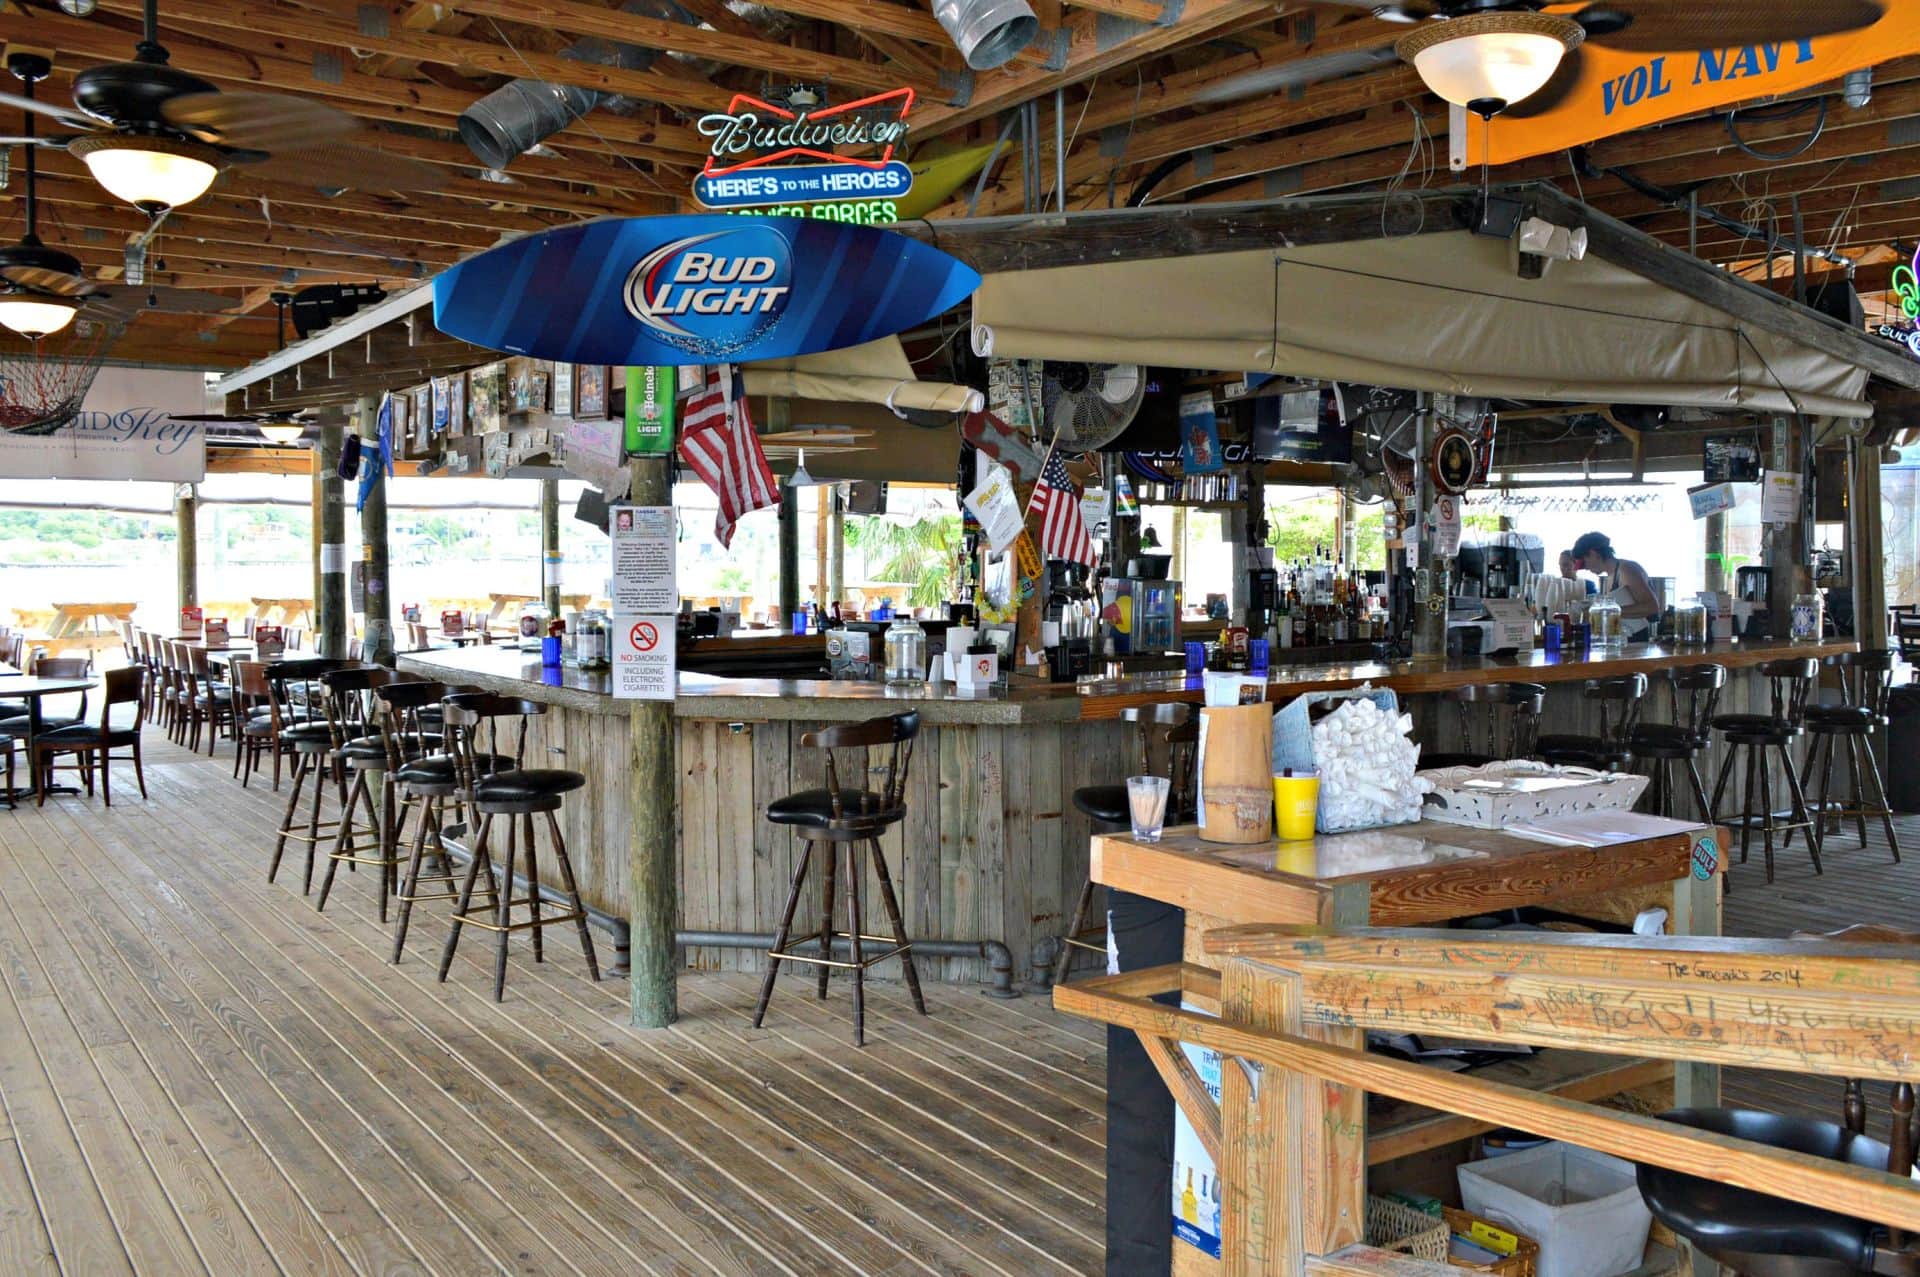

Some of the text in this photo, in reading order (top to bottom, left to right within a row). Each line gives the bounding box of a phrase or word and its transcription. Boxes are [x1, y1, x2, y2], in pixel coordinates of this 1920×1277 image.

[1602, 56, 1671, 116] VOL
[697, 112, 910, 156] Budweiser
[708, 170, 901, 198] HERE'S TO THE HEROES
[674, 253, 776, 283] BUD
[650, 283, 790, 315] LIGHT
[637, 425, 662, 433] LIGHT
[620, 654, 668, 663] NO SMOKING
[624, 667, 665, 676] INCLUDING
[623, 676, 665, 684] ELECTRONIC
[623, 684, 666, 693] CIGARETTES
[1661, 961, 1689, 979] The
[1759, 968, 1802, 989] 2014
